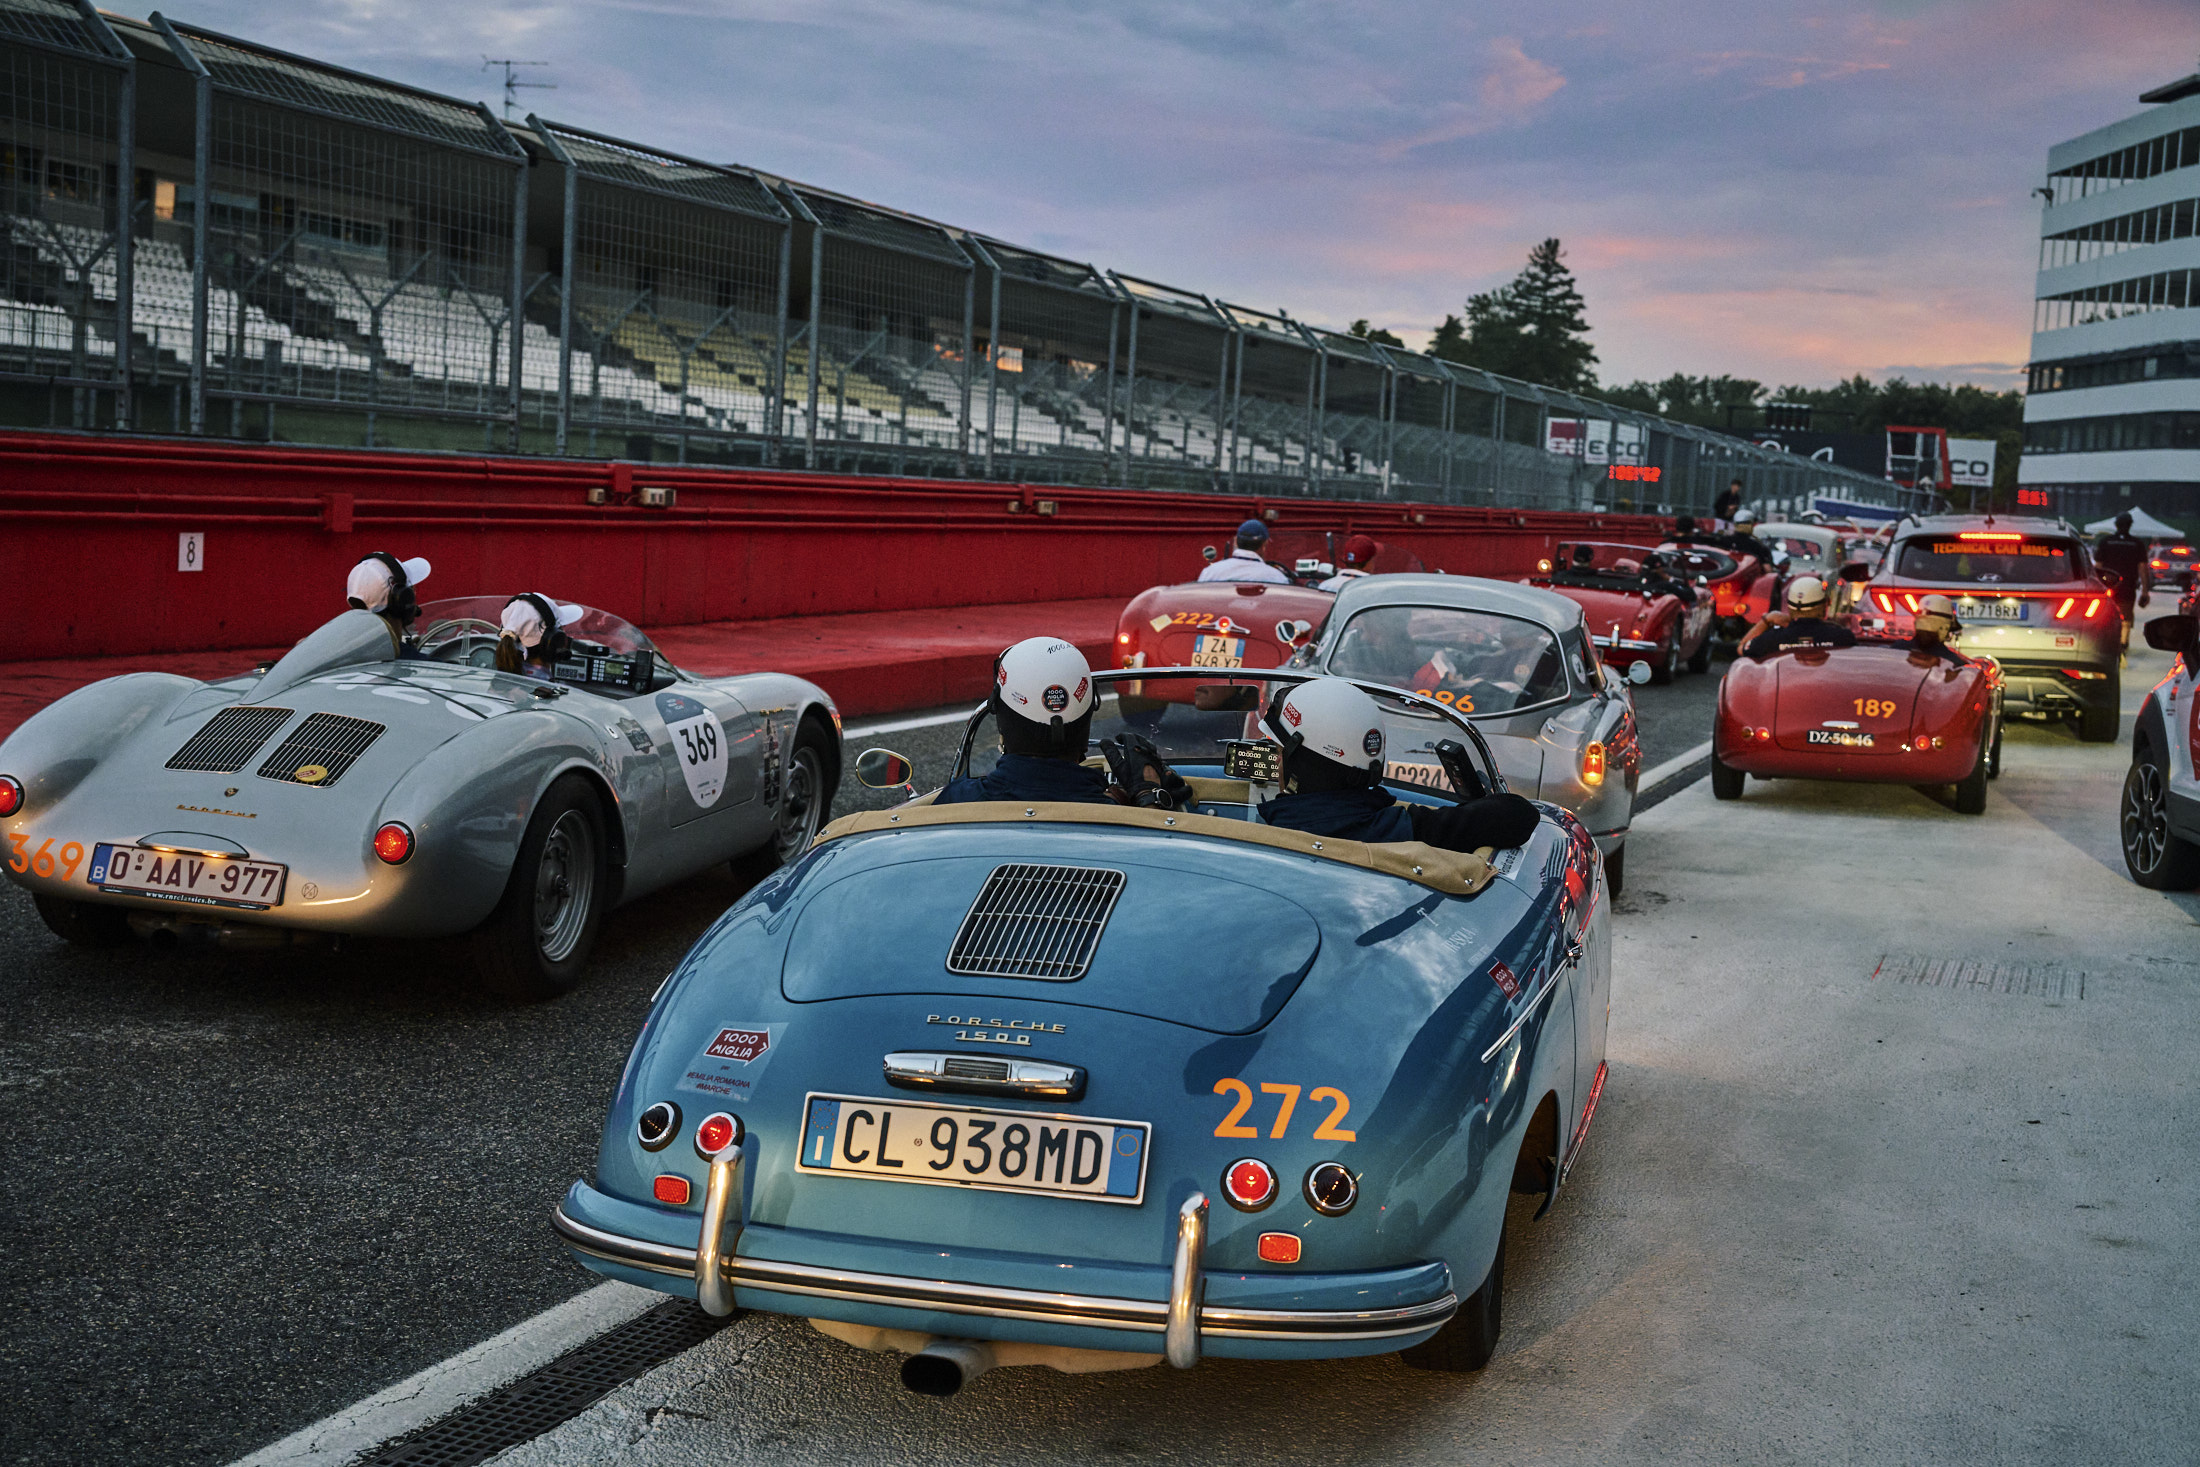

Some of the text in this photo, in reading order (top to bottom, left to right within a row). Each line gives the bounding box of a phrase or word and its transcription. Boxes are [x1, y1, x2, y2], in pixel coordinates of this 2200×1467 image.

[1932, 543, 1993, 554] TECHNICAL
[1994, 543, 2019, 555] CAR
[1172, 611, 1215, 625] 222
[1210, 638, 1227, 653] ZA
[1853, 698, 1897, 719] 189
[679, 722, 717, 766] 369
[8, 832, 86, 882] 369
[92, 865, 104, 880] B
[926, 1014, 1066, 1033] PORSCHE
[723, 1032, 759, 1045] 1000
[955, 1030, 1031, 1046] 1500
[710, 1044, 754, 1058] MIGLIA
[686, 1071, 751, 1089] #EMILIA ROMAGNA
[696, 1083, 731, 1095] #MARCHE
[1213, 1077, 1358, 1142] 272
[842, 1109, 1104, 1186] CL 938MD
